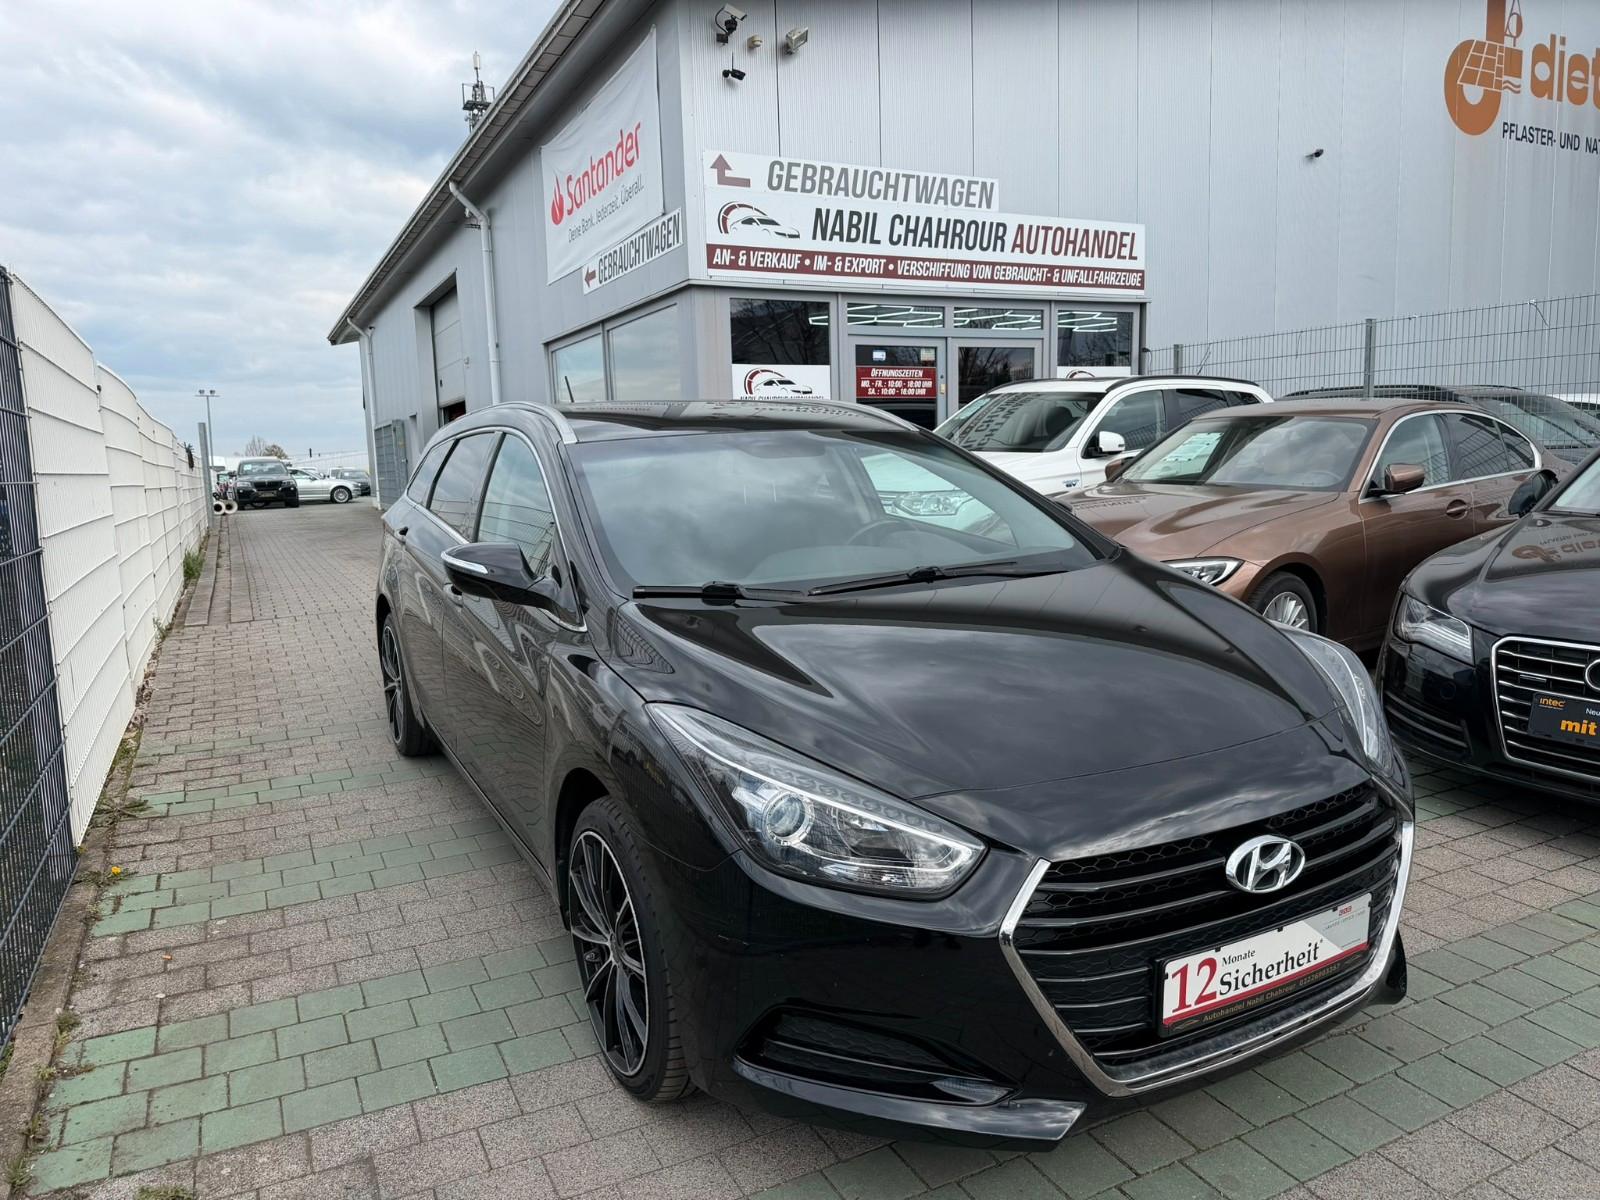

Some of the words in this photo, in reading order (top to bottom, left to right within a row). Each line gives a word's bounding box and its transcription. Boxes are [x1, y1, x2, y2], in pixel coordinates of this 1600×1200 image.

[1502, 121, 1556, 147] PFLASTER-
[1560, 131, 1580, 151] UND
[566, 121, 641, 216] Santander
[767, 160, 995, 209] GEBRAUCHTWAGEN
[598, 212, 681, 284] GEBRAUCHTWAGEN
[812, 207, 881, 245] NABIL
[888, 213, 1008, 253] CHAHROUR
[1010, 223, 1138, 261] AUTOHANDEL
[713, 248, 735, 266] AN-
[738, 250, 747, 266] &
[750, 250, 802, 270] VERKAUF
[813, 254, 832, 272] IM-
[834, 256, 842, 272] &
[844, 256, 886, 275] EXPORT
[897, 260, 970, 279] VERSCHIFFUNG
[972, 264, 993, 280] VON
[994, 265, 1051, 283] GEBRAUCHT-
[1053, 270, 1060, 282] &
[1061, 270, 1143, 287] UNFALLFAHRZEUGE
[871, 368, 924, 377] ÖFFNUNGSZEITEN
[1539, 697, 1566, 707] intec
[1560, 719, 1597, 736] mit
[1171, 956, 1218, 1014] 12
[1221, 949, 1256, 967] Monate
[1203, 1001, 1245, 1023] Autohandel
[1246, 993, 1265, 1007] Nabil
